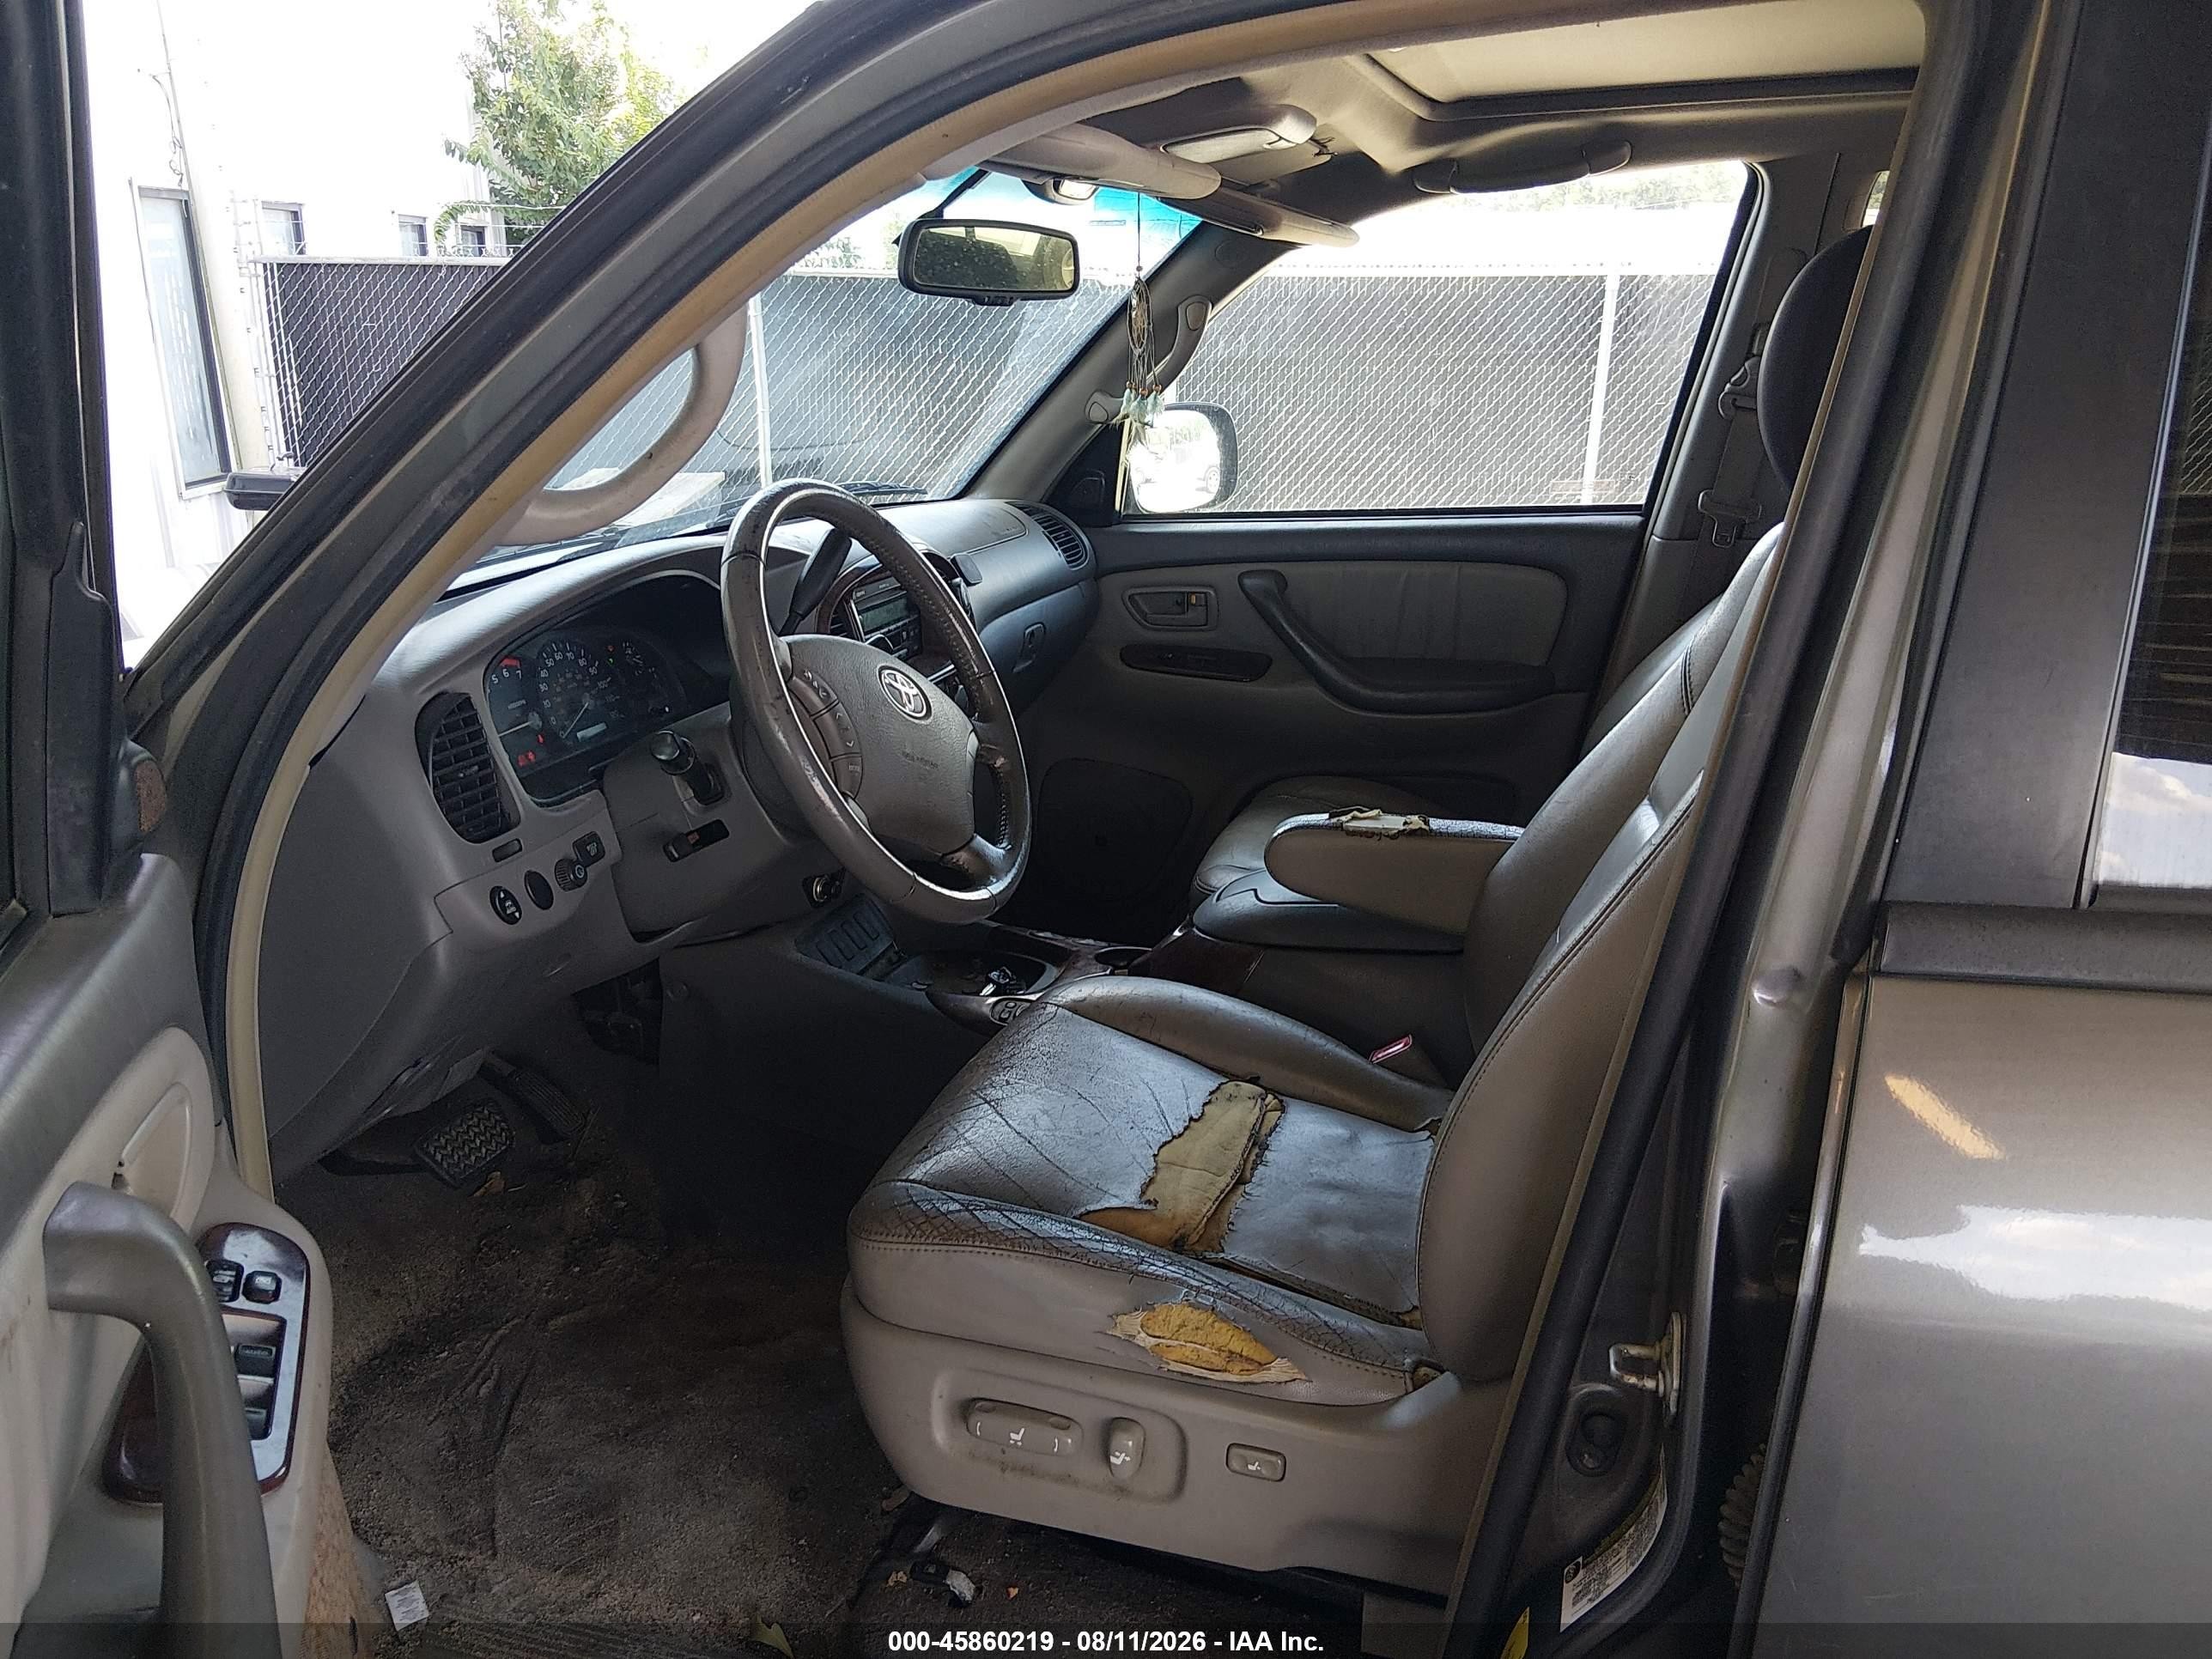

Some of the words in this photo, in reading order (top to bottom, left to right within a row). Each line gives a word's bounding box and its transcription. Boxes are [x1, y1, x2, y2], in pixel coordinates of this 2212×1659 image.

[554, 652, 563, 660] 60
[566, 652, 575, 661] 70
[545, 658, 555, 668] 50
[578, 658, 587, 667] 80
[540, 669, 550, 678] 40
[588, 666, 598, 676] 90
[491, 674, 499, 684] 5
[502, 668, 510, 678] 6
[515, 670, 523, 680] 7
[538, 683, 549, 693] 30
